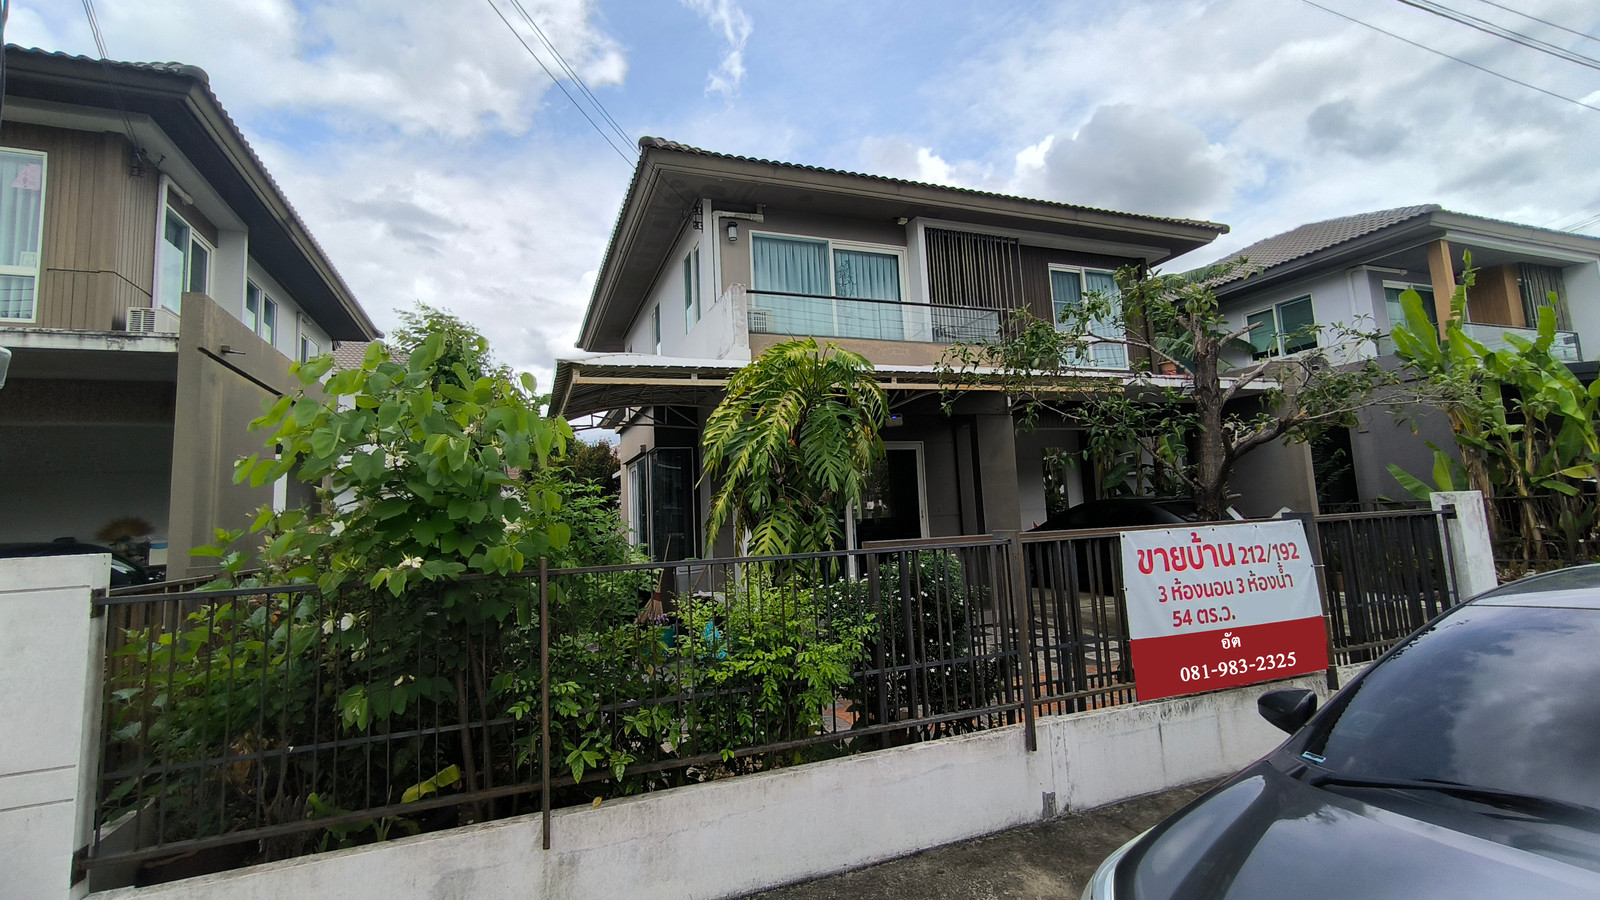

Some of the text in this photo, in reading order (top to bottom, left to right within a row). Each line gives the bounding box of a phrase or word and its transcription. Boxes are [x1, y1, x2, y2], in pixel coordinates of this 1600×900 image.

[1137, 532, 1300, 574] ขายบ้าน 212/192
[1158, 562, 1294, 603] 3 ห้องนอน 3 ห้องน้ำ
[1172, 606, 1236, 628] 54 ตร.ว.
[1180, 652, 1297, 682] 081-983-2325
